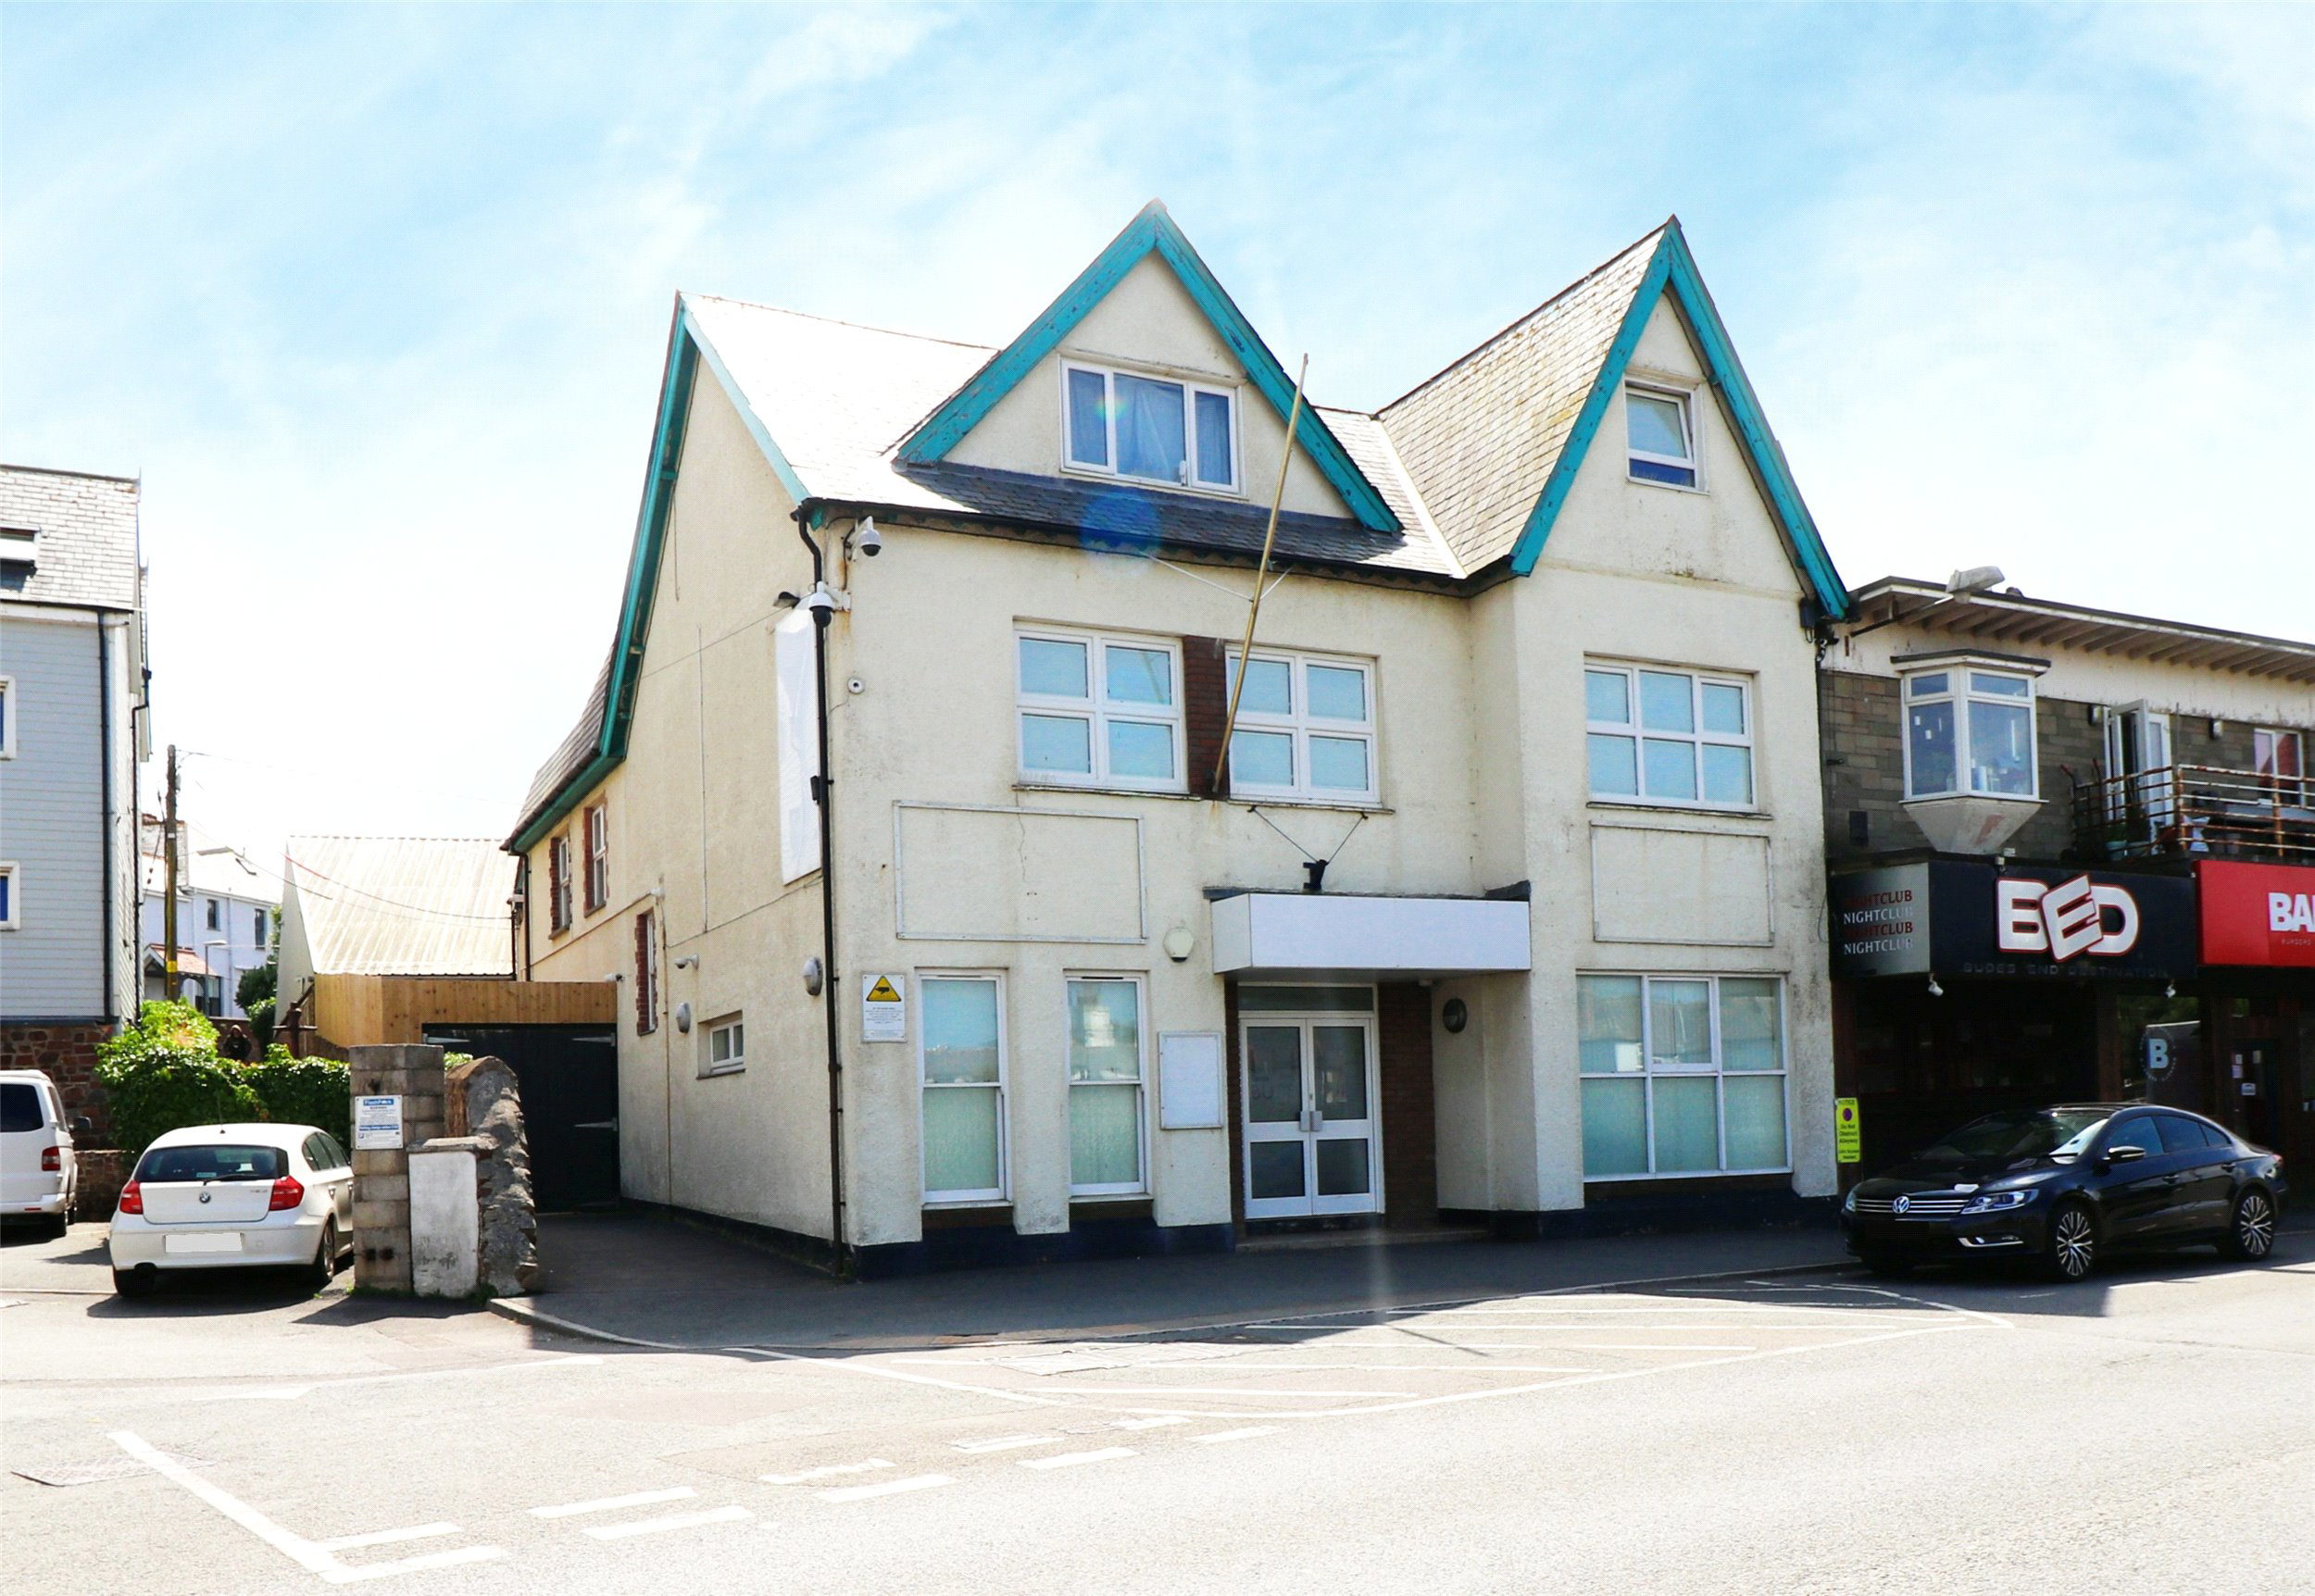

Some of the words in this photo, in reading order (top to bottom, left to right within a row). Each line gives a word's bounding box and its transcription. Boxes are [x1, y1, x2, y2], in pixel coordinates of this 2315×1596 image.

[1844, 906, 1913, 925] NIGHTCLUB
[1996, 873, 2138, 962] BED
[2268, 892, 2315, 933] BA
[1845, 939, 1913, 955] NIGHTCLUB
[2028, 964, 2059, 975] END
[2149, 1038, 2169, 1068] B
